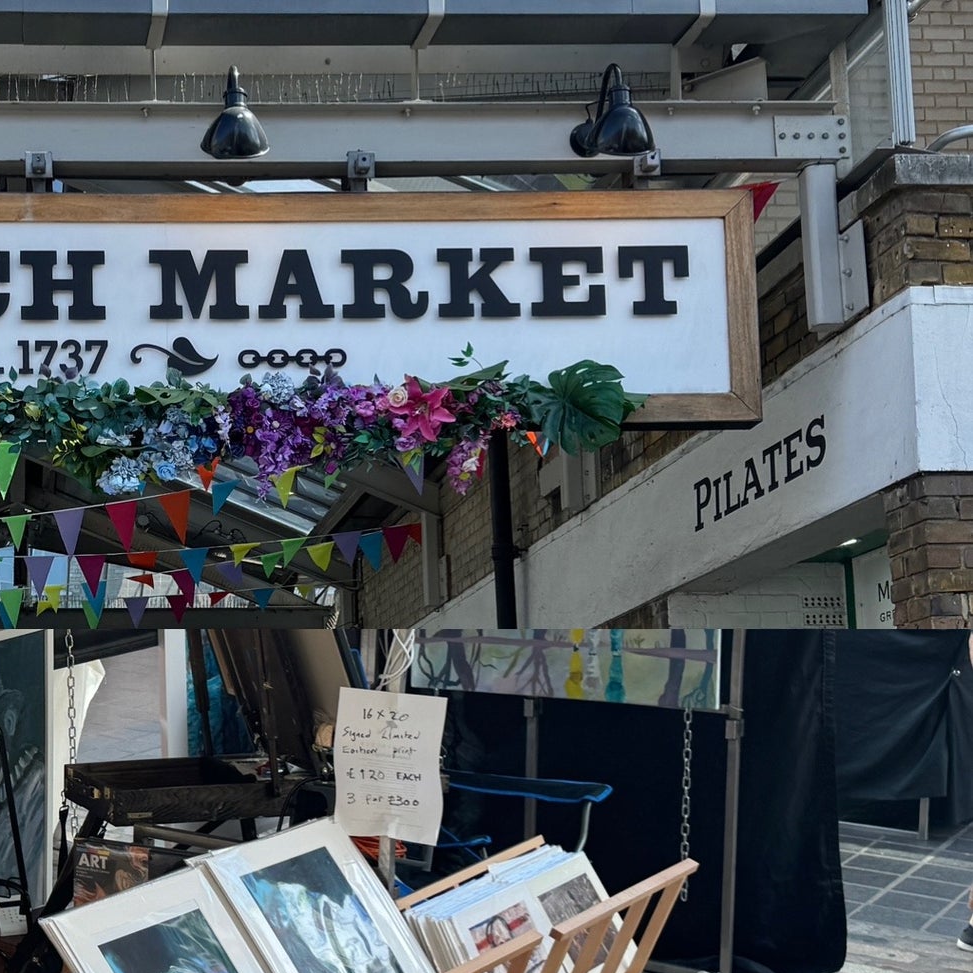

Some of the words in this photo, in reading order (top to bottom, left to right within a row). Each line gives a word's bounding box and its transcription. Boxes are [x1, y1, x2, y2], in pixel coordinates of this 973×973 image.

[148, 244, 690, 322] MARKET
[693, 414, 826, 532] PILATES
[389, 711, 409, 722] 20
[396, 773, 422, 782] EACH
[346, 793, 356, 804] 3
[78, 853, 108, 870] ART
